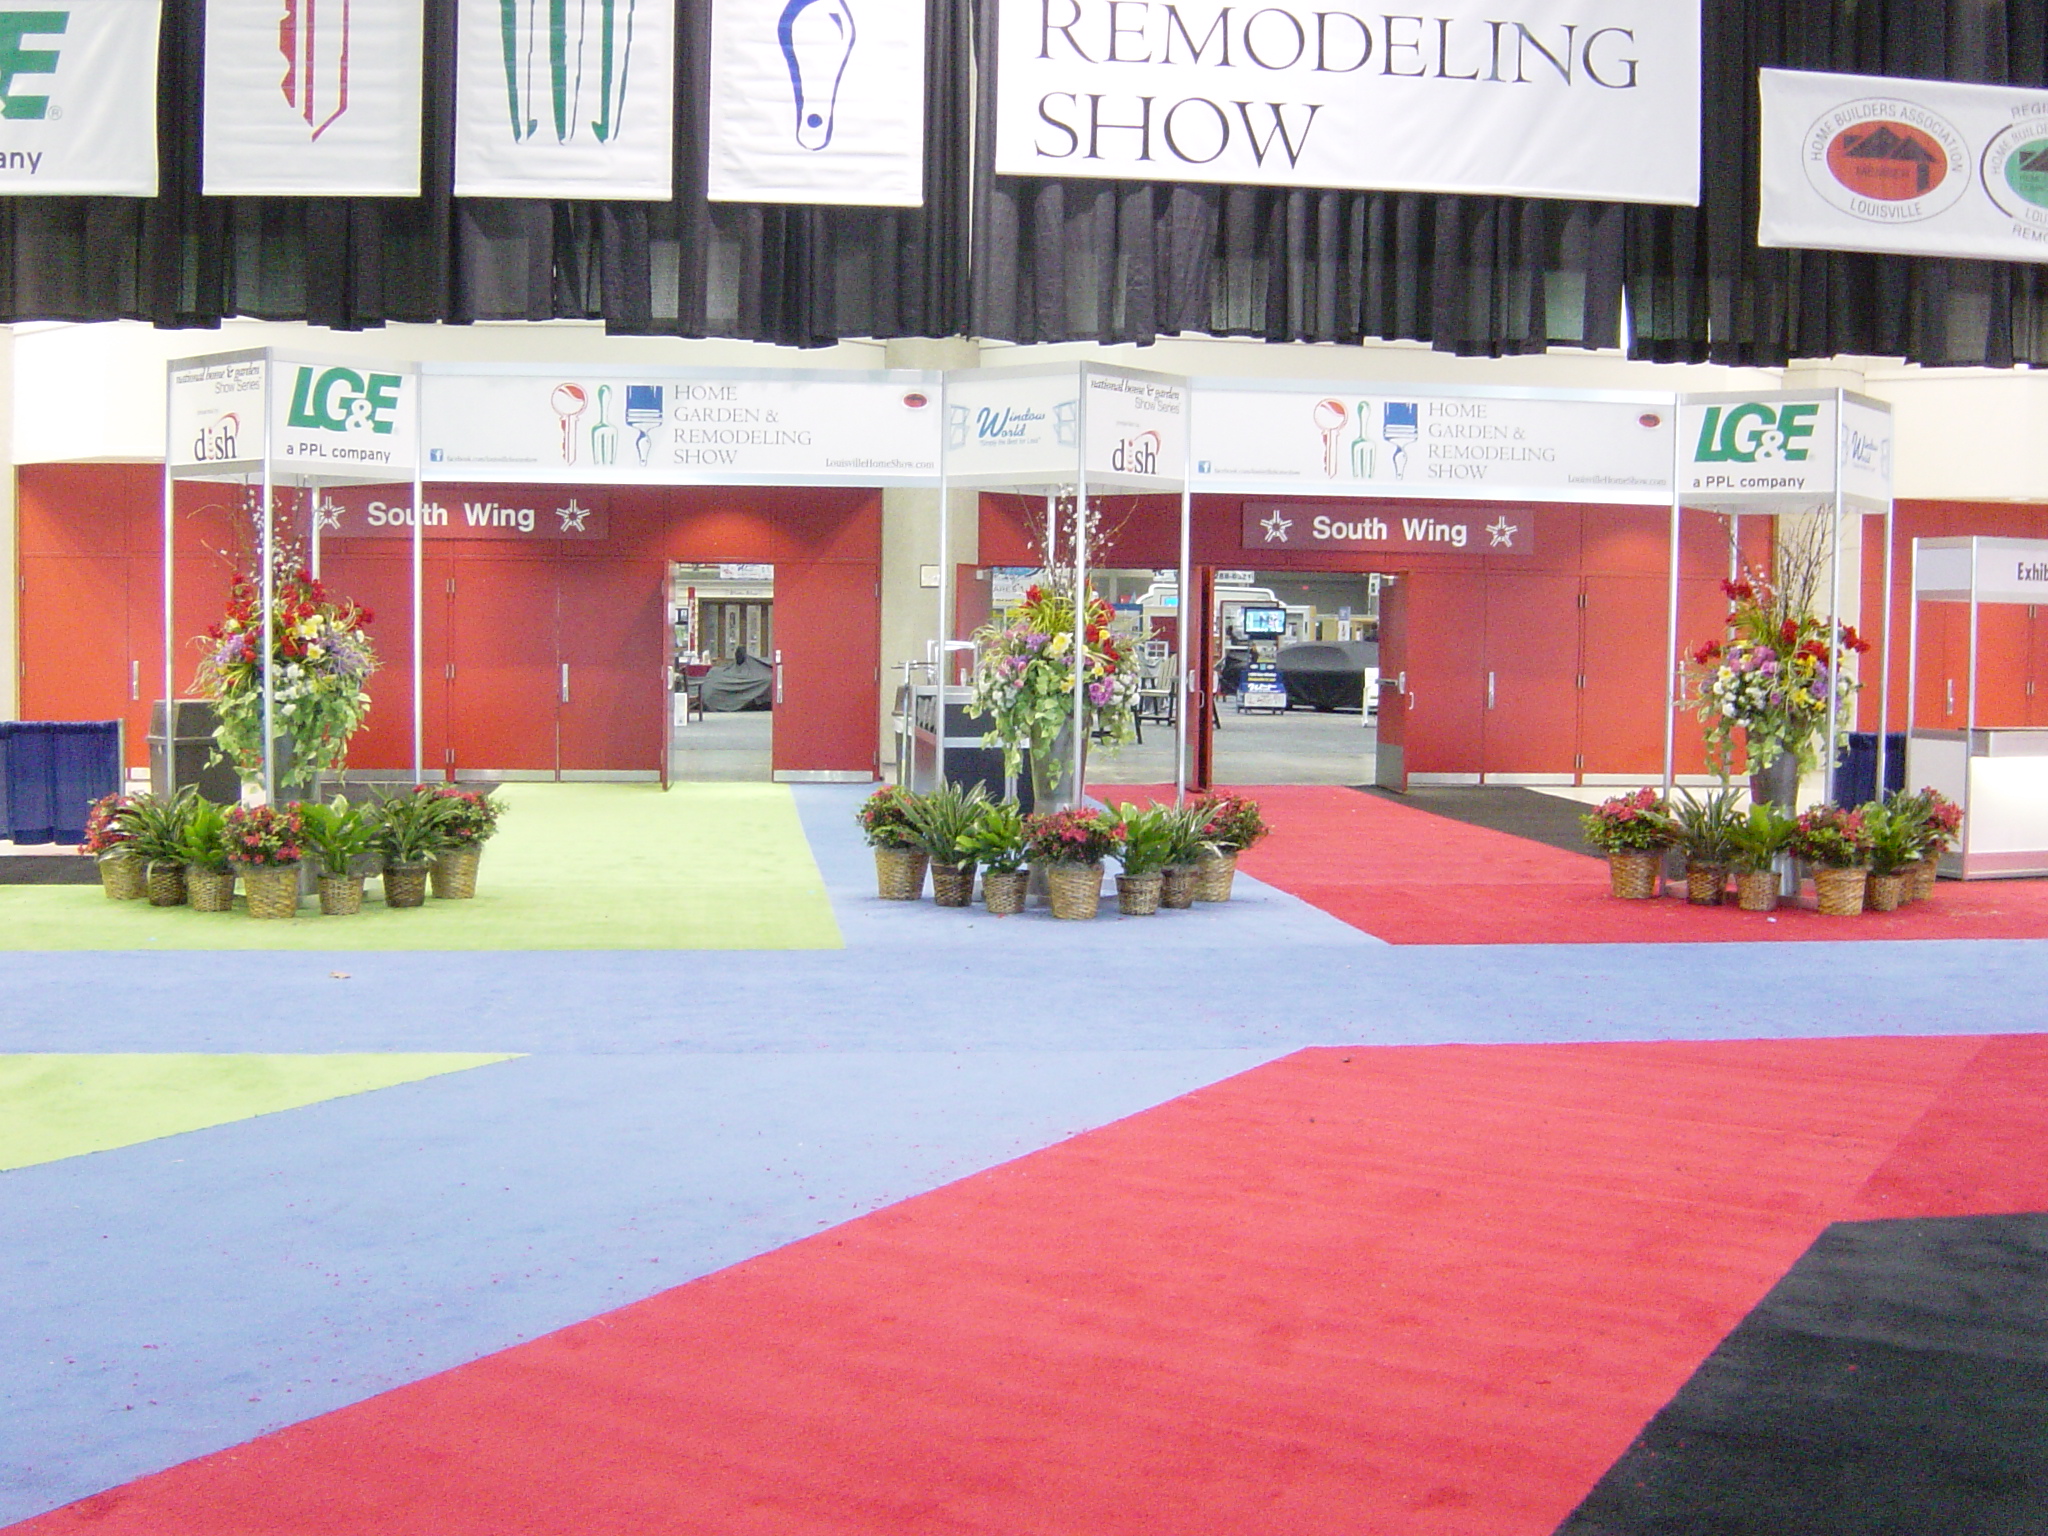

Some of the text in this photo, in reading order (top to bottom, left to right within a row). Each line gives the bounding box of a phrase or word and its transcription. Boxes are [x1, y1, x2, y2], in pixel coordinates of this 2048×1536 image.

[1035, 0, 1639, 88] REMODELING
[1034, 92, 1323, 170] SHOW
[1811, 103, 1964, 174] HOME BUILDERS ASSOCIATION
[1850, 197, 1922, 218] LOUISVILLE
[215, 380, 260, 394] Show Series
[675, 385, 737, 401] HOME
[1091, 379, 1124, 393] national
[1154, 387, 1180, 402] garden
[287, 366, 403, 434] LG&E
[1135, 396, 1180, 414] Show Series
[674, 407, 779, 423] GARDEN &
[1429, 403, 1487, 419] HOME
[976, 406, 1046, 439] Window
[1428, 423, 1525, 440] GARDEN &
[1694, 403, 1820, 463] LG&E
[194, 424, 239, 462] dish
[674, 429, 812, 446] REMODELING
[286, 442, 391, 463] a PPL company
[673, 449, 738, 465] SHOW
[1112, 437, 1157, 475] dish
[1428, 444, 1555, 462] REMODELING
[825, 458, 935, 470] LouisvilleHomeShow.com
[1428, 464, 1488, 480] SHOW
[1693, 476, 1805, 489] a PPL company
[367, 501, 535, 532] South Wing
[1312, 515, 1467, 547] South Wing
